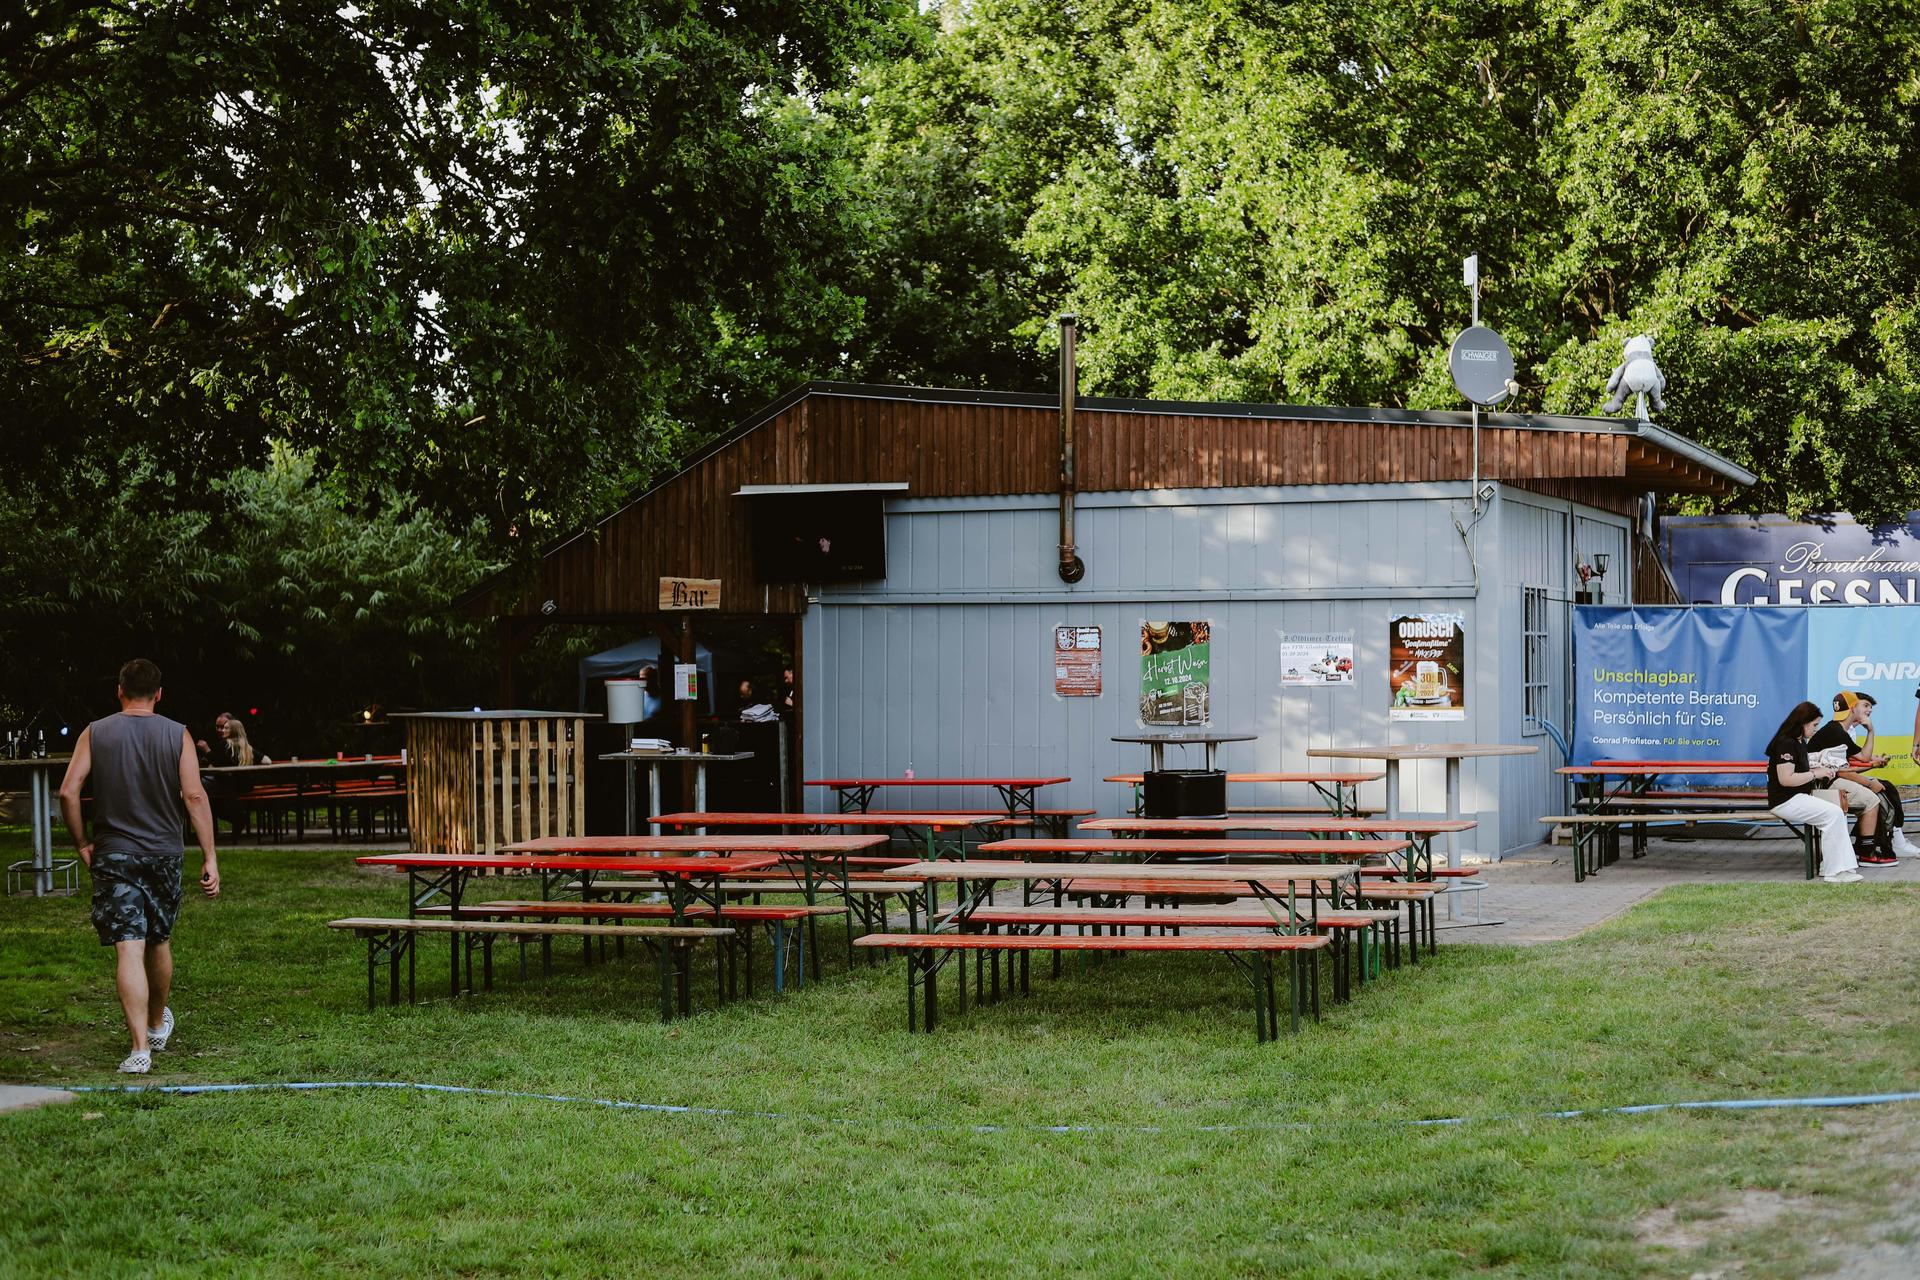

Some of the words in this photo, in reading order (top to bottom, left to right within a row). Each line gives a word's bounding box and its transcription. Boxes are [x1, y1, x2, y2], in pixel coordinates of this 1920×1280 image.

[1779, 541, 1920, 574] Privatbraue
[671, 581, 708, 607] Bar
[1721, 567, 1916, 604] GESSN
[1398, 621, 1454, 638] ODRUSCH
[1593, 621, 1606, 630] Alle
[1143, 653, 1178, 682] Herbst
[1164, 674, 1192, 686] 12.10.2024
[1593, 669, 1698, 687] Unschlagbar.
[1593, 689, 1685, 706] Kompetente
[1689, 690, 1760, 709] Beratung.
[1593, 710, 1671, 726] Persönlich
[1675, 711, 1696, 725] für
[1700, 712, 1727, 726] Sie.
[1592, 736, 1621, 745] Conrad
[1622, 737, 1662, 746] Profistore.
[1663, 738, 1676, 746] Für
[1677, 738, 1690, 746] Sie
